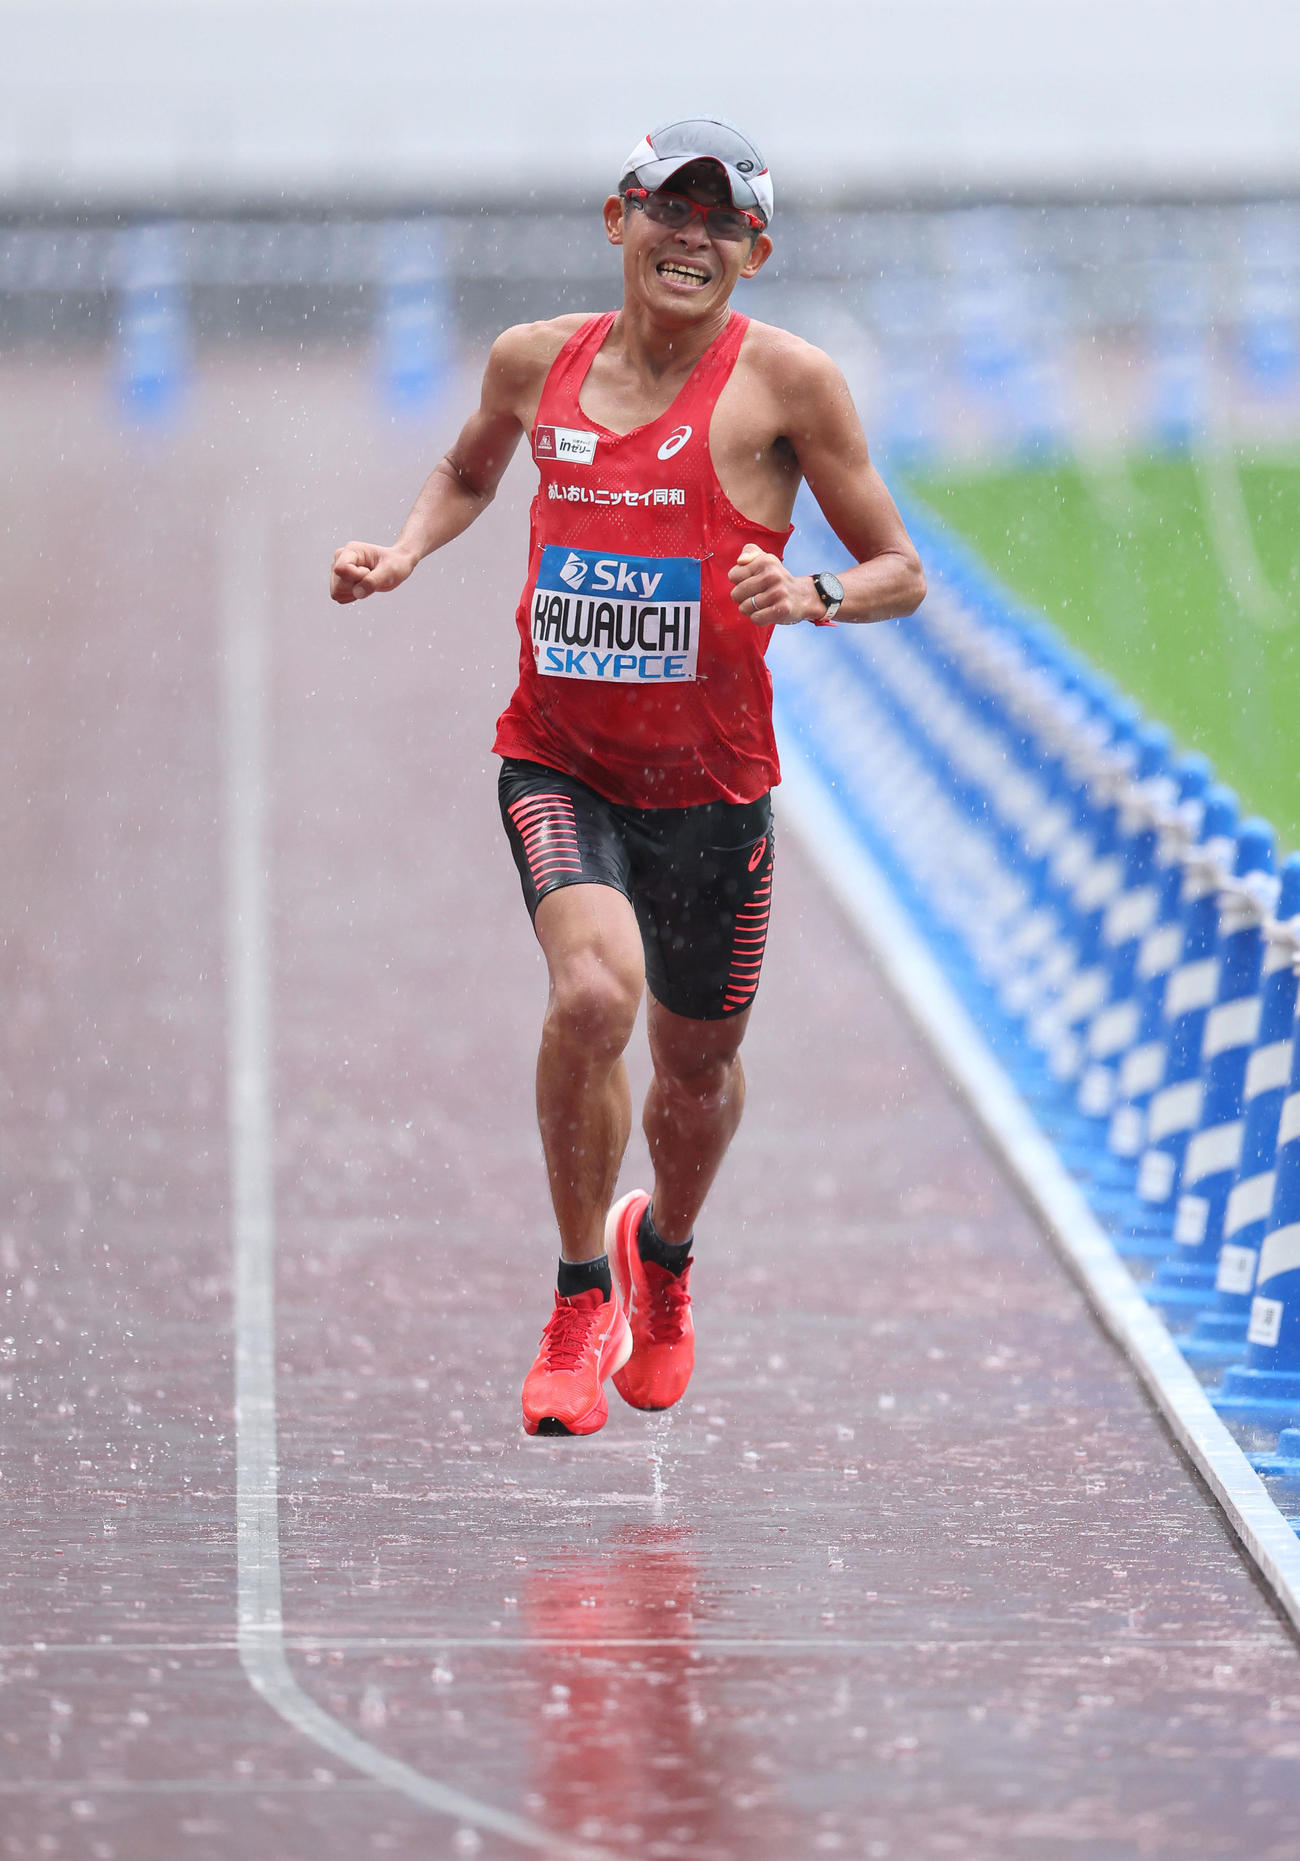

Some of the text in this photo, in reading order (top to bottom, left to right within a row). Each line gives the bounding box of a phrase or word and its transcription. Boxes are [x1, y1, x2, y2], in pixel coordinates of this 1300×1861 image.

[548, 483, 686, 506] あいおいニッセイ同和
[591, 559, 664, 599] Sky
[533, 593, 691, 651] KAWAUCHI
[544, 646, 688, 679] SKYPCE
